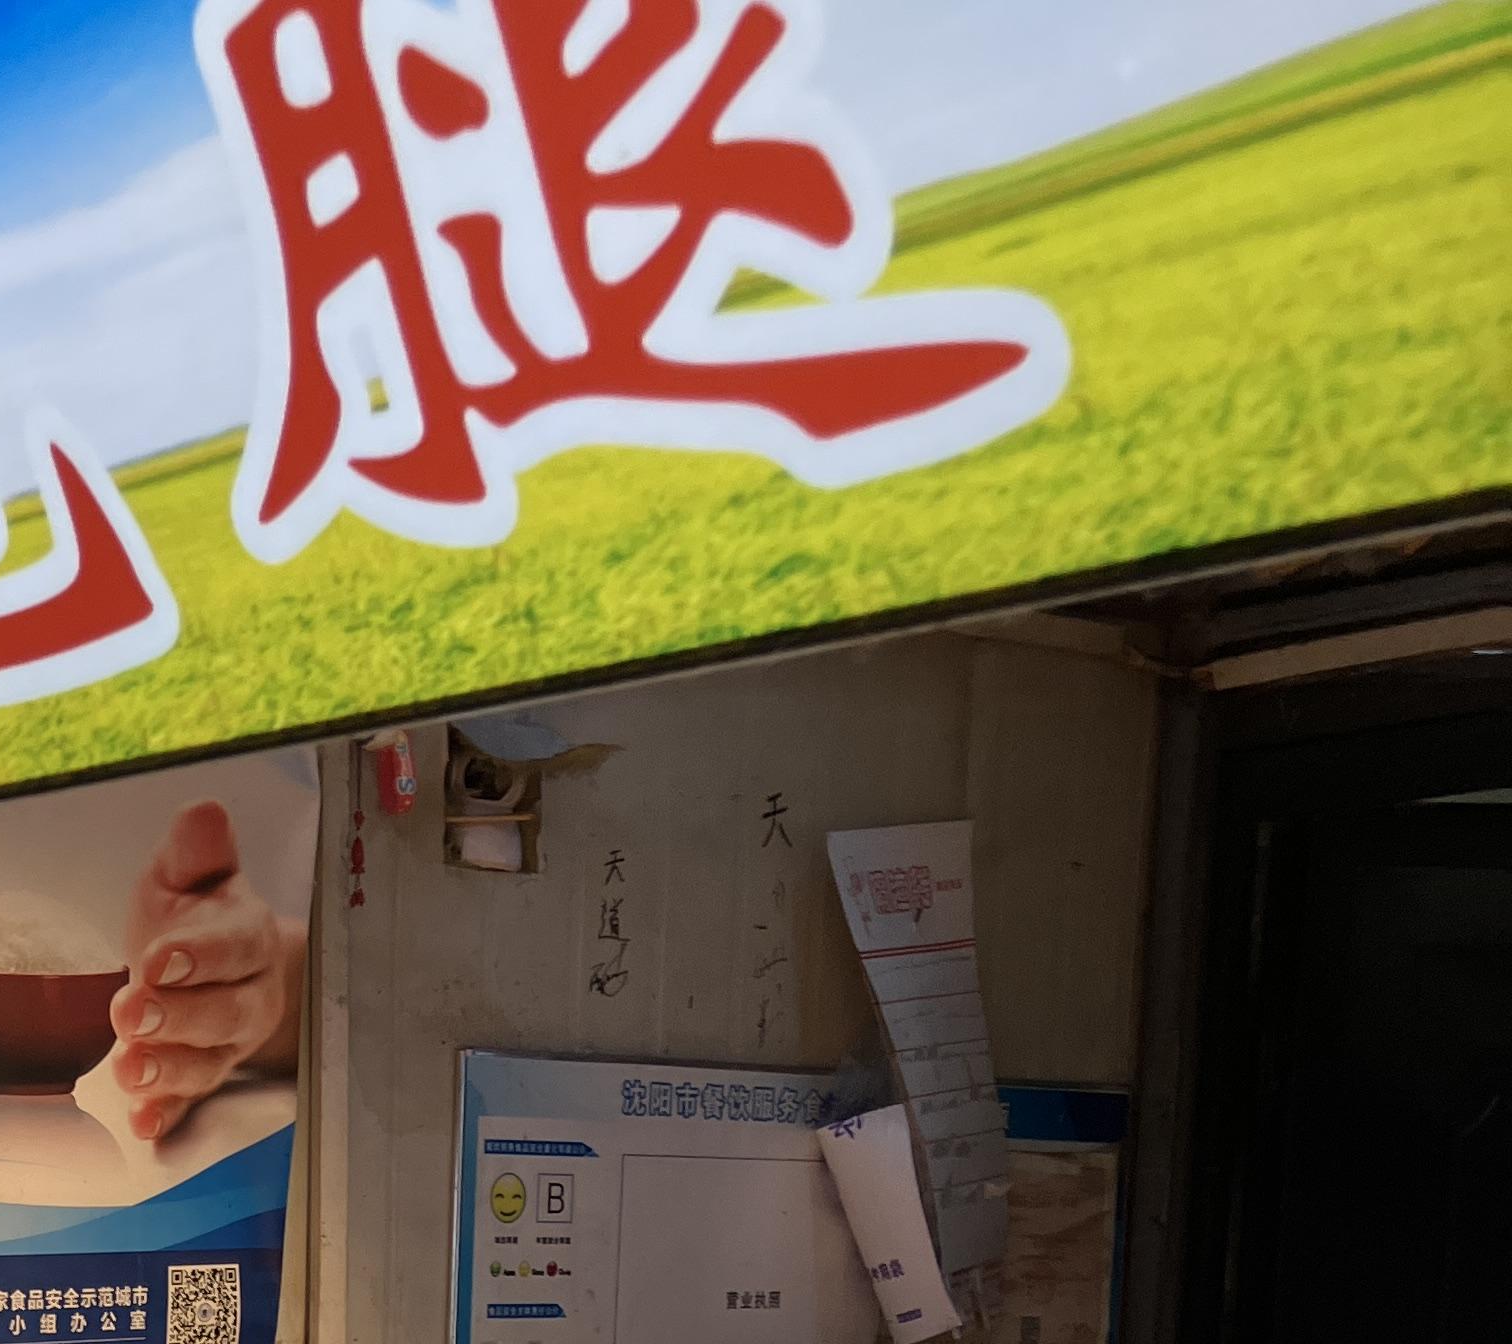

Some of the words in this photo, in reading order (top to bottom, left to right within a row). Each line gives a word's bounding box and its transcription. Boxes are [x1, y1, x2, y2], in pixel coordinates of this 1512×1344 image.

[622, 1079, 835, 1125] 沈阳市餐饮服务食
[546, 1181, 566, 1215] B
[725, 1290, 782, 1310] 营业执照
